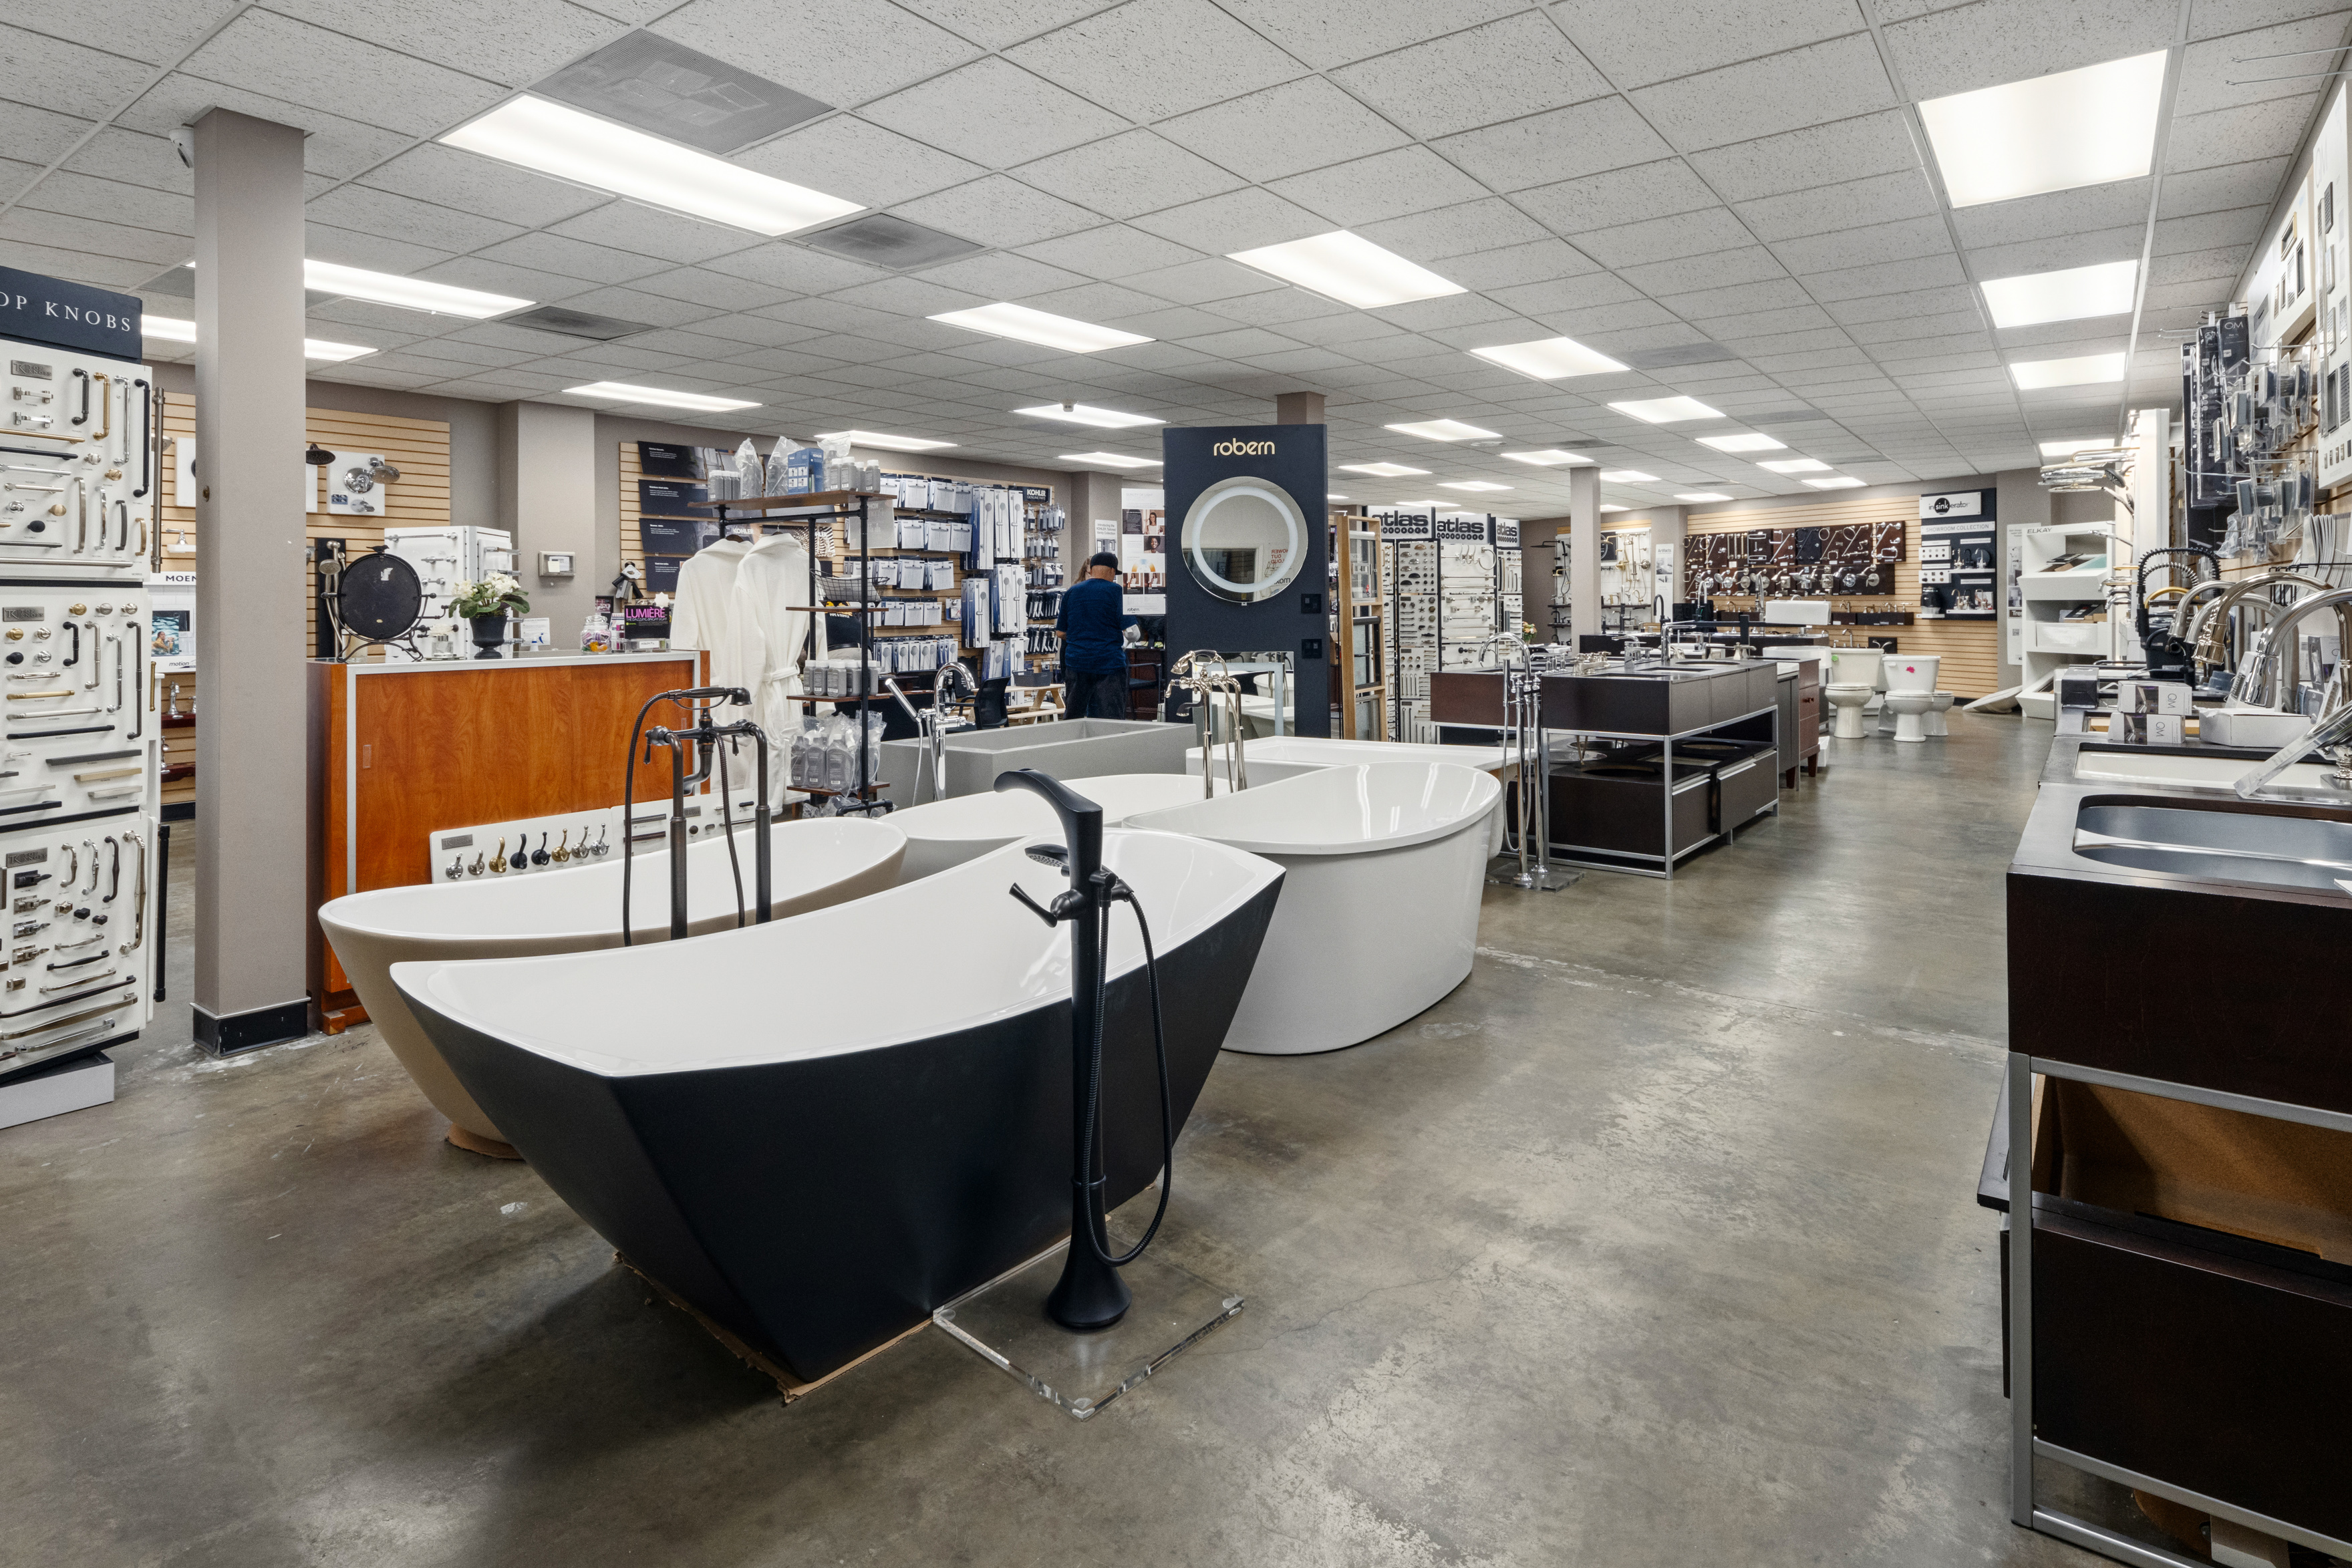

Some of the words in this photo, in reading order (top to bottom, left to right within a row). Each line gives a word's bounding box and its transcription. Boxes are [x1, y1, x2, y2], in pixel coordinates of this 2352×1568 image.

[45, 301, 131, 331] KNOBS
[1213, 438, 1275, 456] robern
[1437, 518, 1484, 534] atlas
[1497, 522, 1517, 536] atlas
[625, 607, 666, 618] LUMIÈRE
